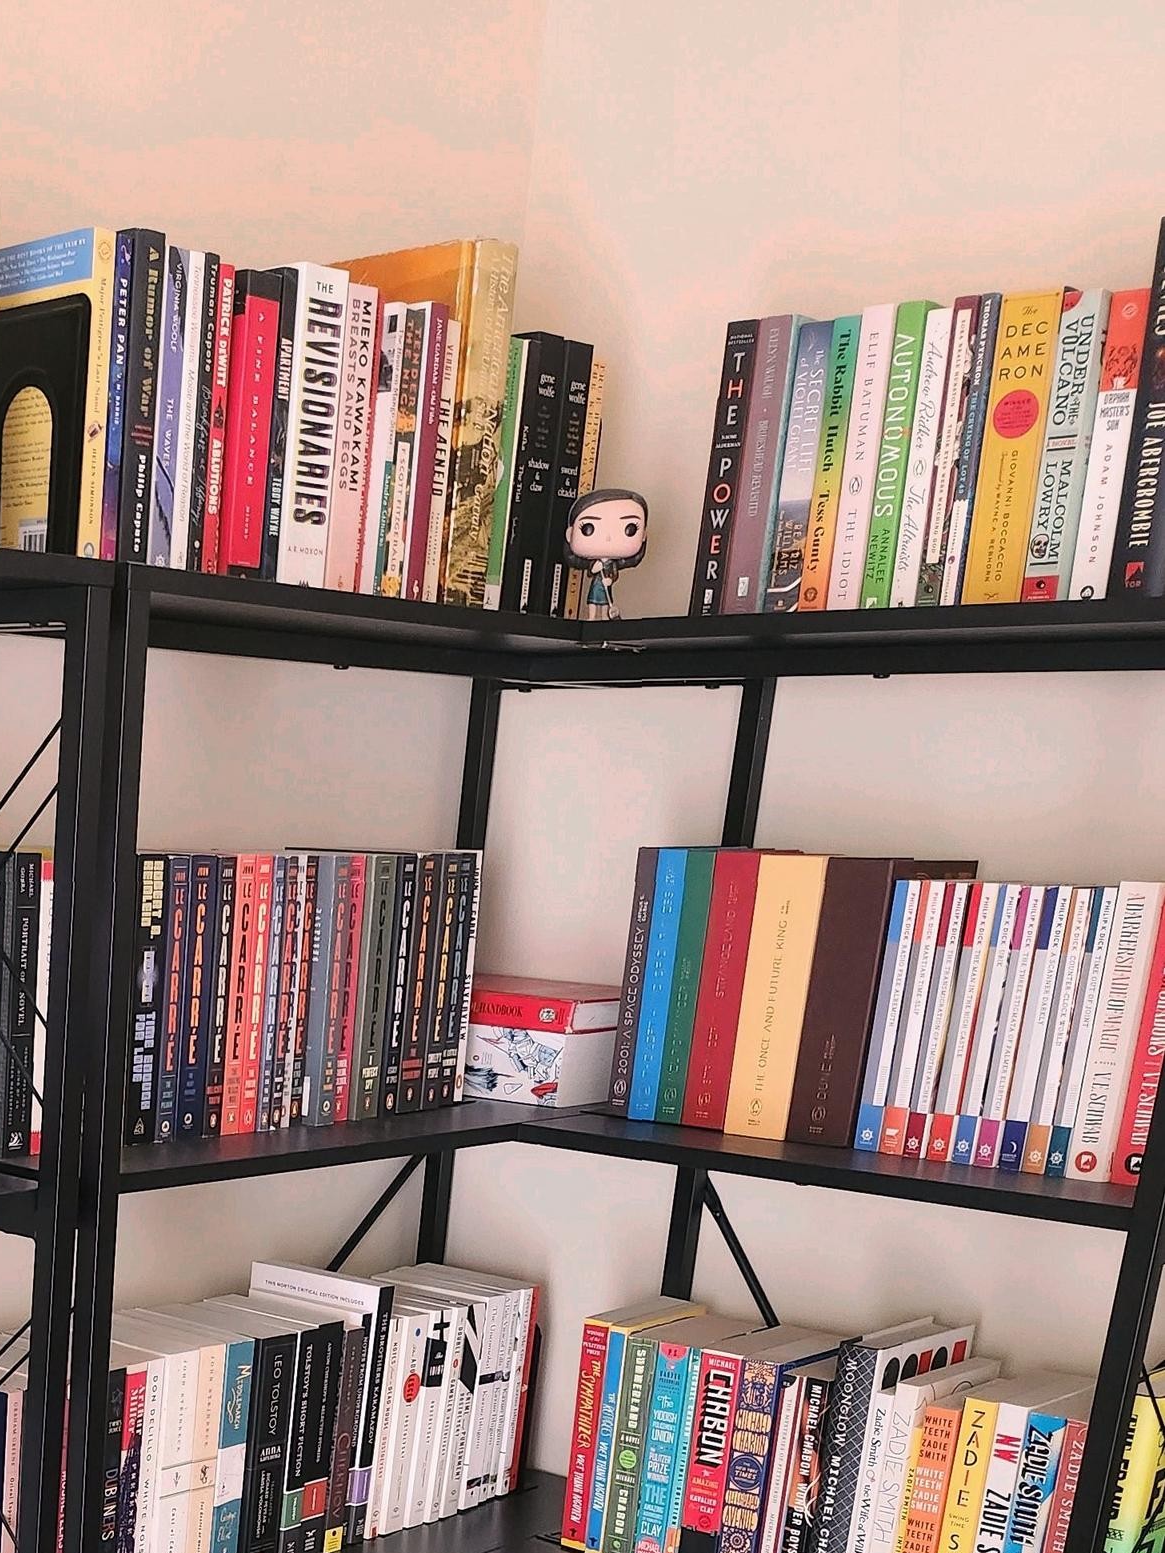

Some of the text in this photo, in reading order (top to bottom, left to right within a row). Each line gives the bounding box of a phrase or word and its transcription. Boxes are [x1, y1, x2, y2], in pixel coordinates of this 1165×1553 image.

[316, 281, 334, 294] THE
[347, 301, 373, 493] MIEKO KAWAKAMI
[821, 329, 851, 474] The Rabbit Hutch
[1053, 320, 1079, 425] VOLCANO
[293, 297, 344, 526] REVISIONARIES
[873, 333, 915, 518] AUTONOMOUS
[1128, 401, 1156, 549] JOE ABERCROMBIE
[197, 883, 207, 901] LE
[268, 1354, 283, 1435] LEO TOLSTOY
[708, 1358, 736, 1370] MICHAEL
[576, 1370, 593, 1449] SYMPATHIZER
[694, 1370, 734, 1468] CHABON
[921, 1439, 948, 1451] ZADIE
[923, 1427, 950, 1439] TEETH
[924, 1416, 953, 1428] WHITE
[919, 1449, 947, 1462] SMITH
[957, 1410, 986, 1507] ZADIE
[994, 1433, 1021, 1464] NW
[101, 1467, 118, 1541] DUBLINERS
[821, 1456, 841, 1523] MICHAEL
[980, 1488, 1011, 1541] ZADIE
